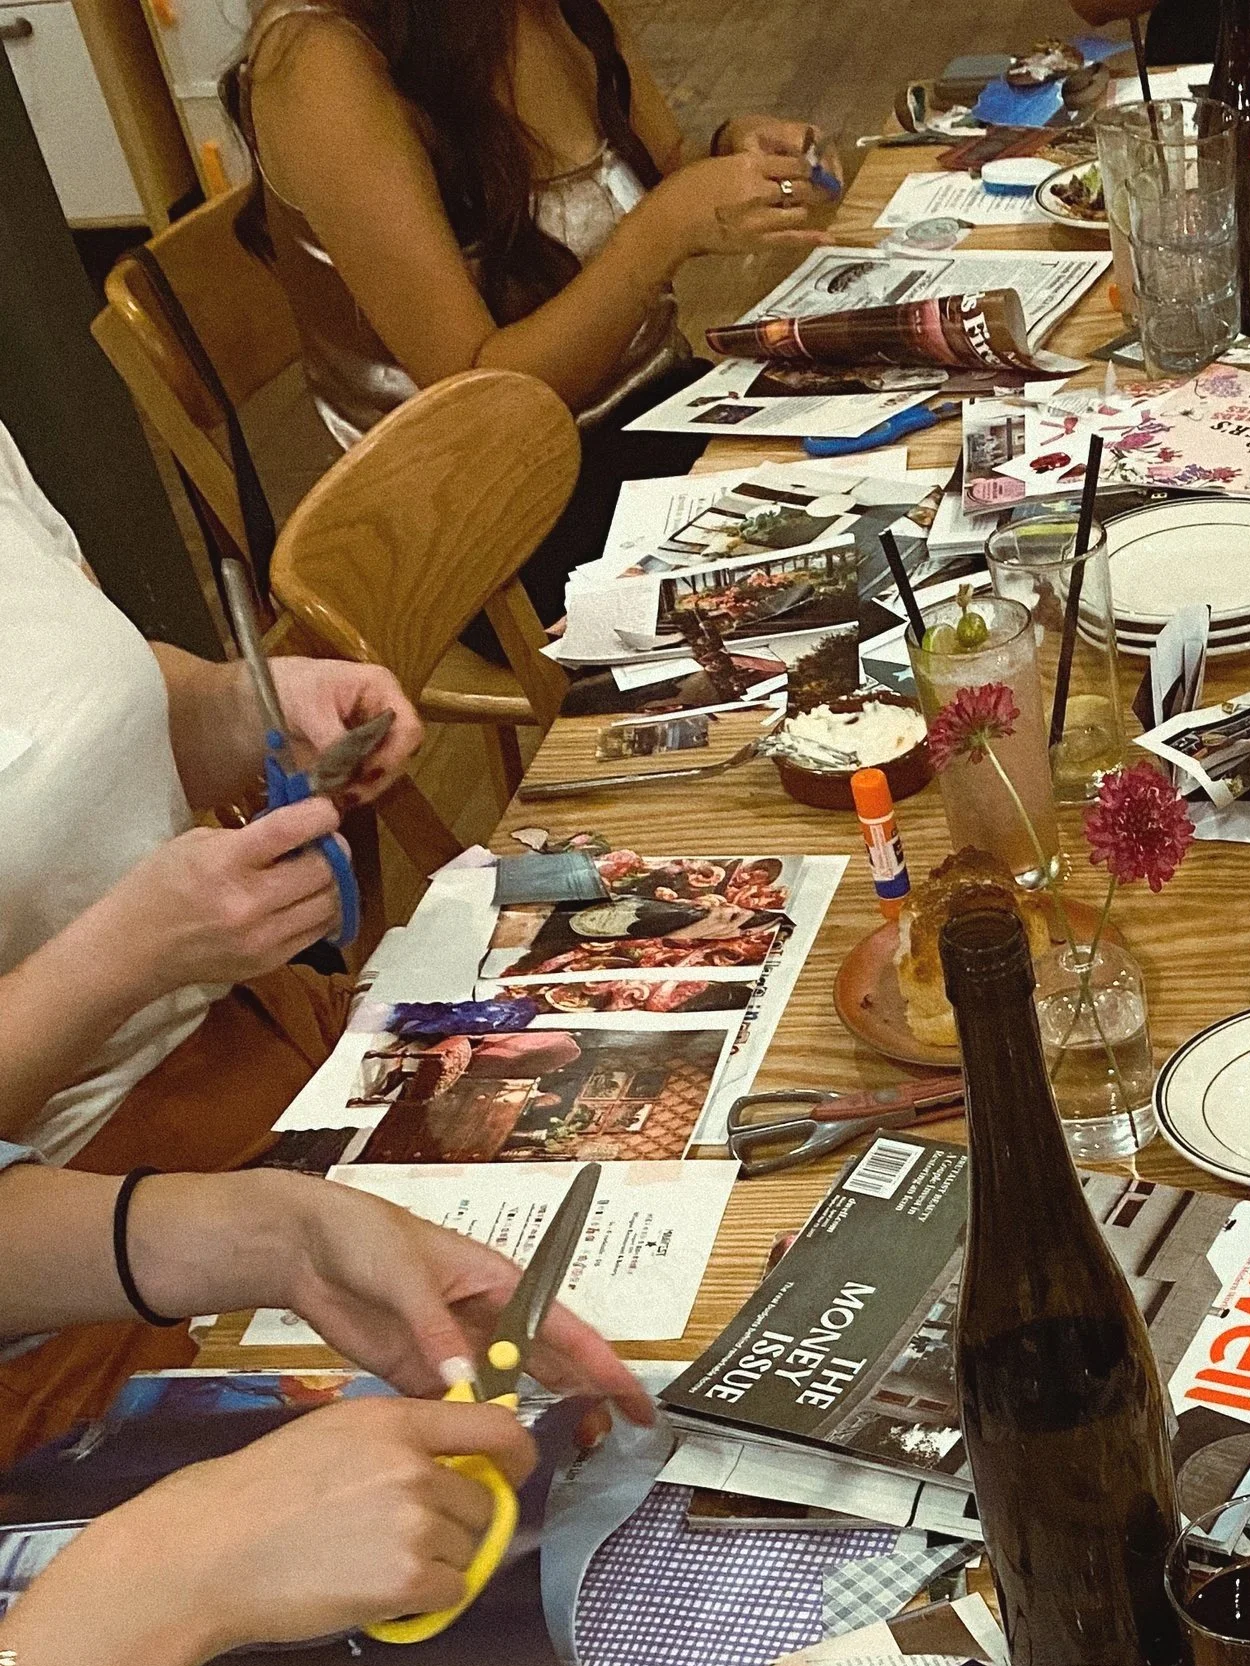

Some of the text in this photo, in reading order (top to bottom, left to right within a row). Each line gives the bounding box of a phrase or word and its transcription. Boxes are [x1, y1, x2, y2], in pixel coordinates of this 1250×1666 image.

[705, 1331, 794, 1403] ISSUE
[775, 1282, 876, 1386] MONEY
[796, 1358, 867, 1409] THE
